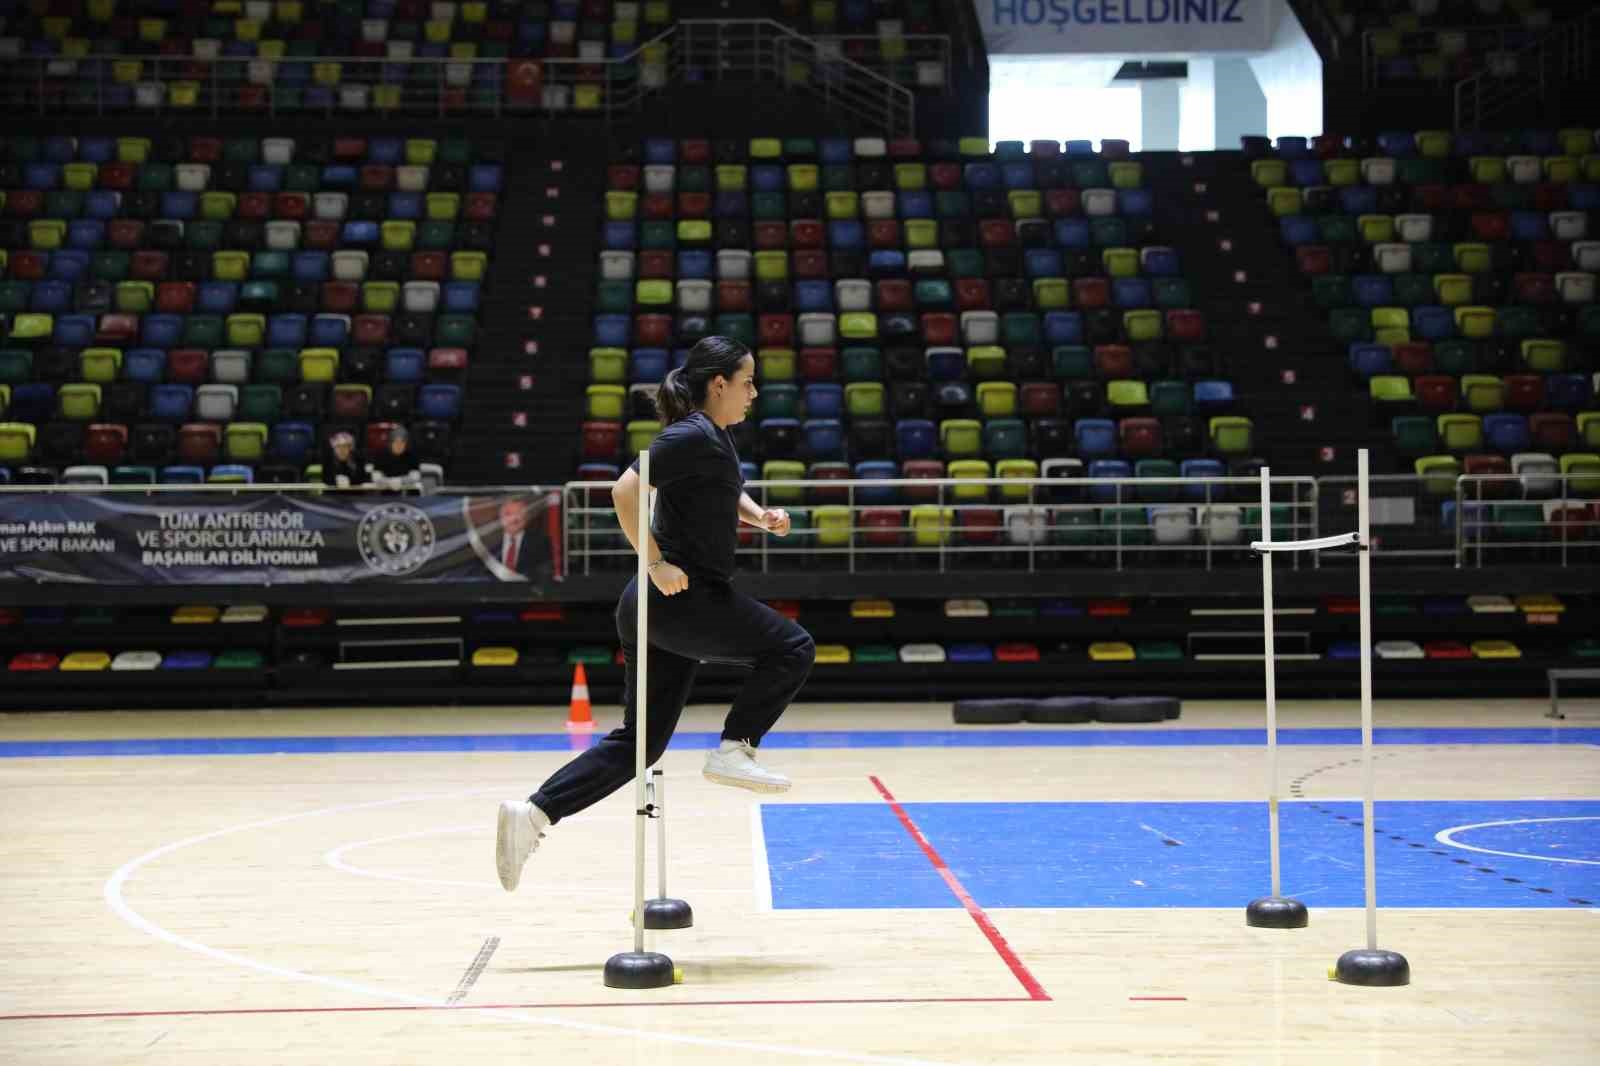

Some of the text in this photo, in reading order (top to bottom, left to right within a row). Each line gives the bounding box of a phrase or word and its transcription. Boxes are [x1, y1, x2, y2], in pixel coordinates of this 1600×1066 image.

[20, 538, 59, 552] SPOR
[61, 538, 116, 552] BAKANI
[136, 530, 325, 548] VE SPORCULARIMIZA
[142, 551, 229, 567] BAŞARILAR
